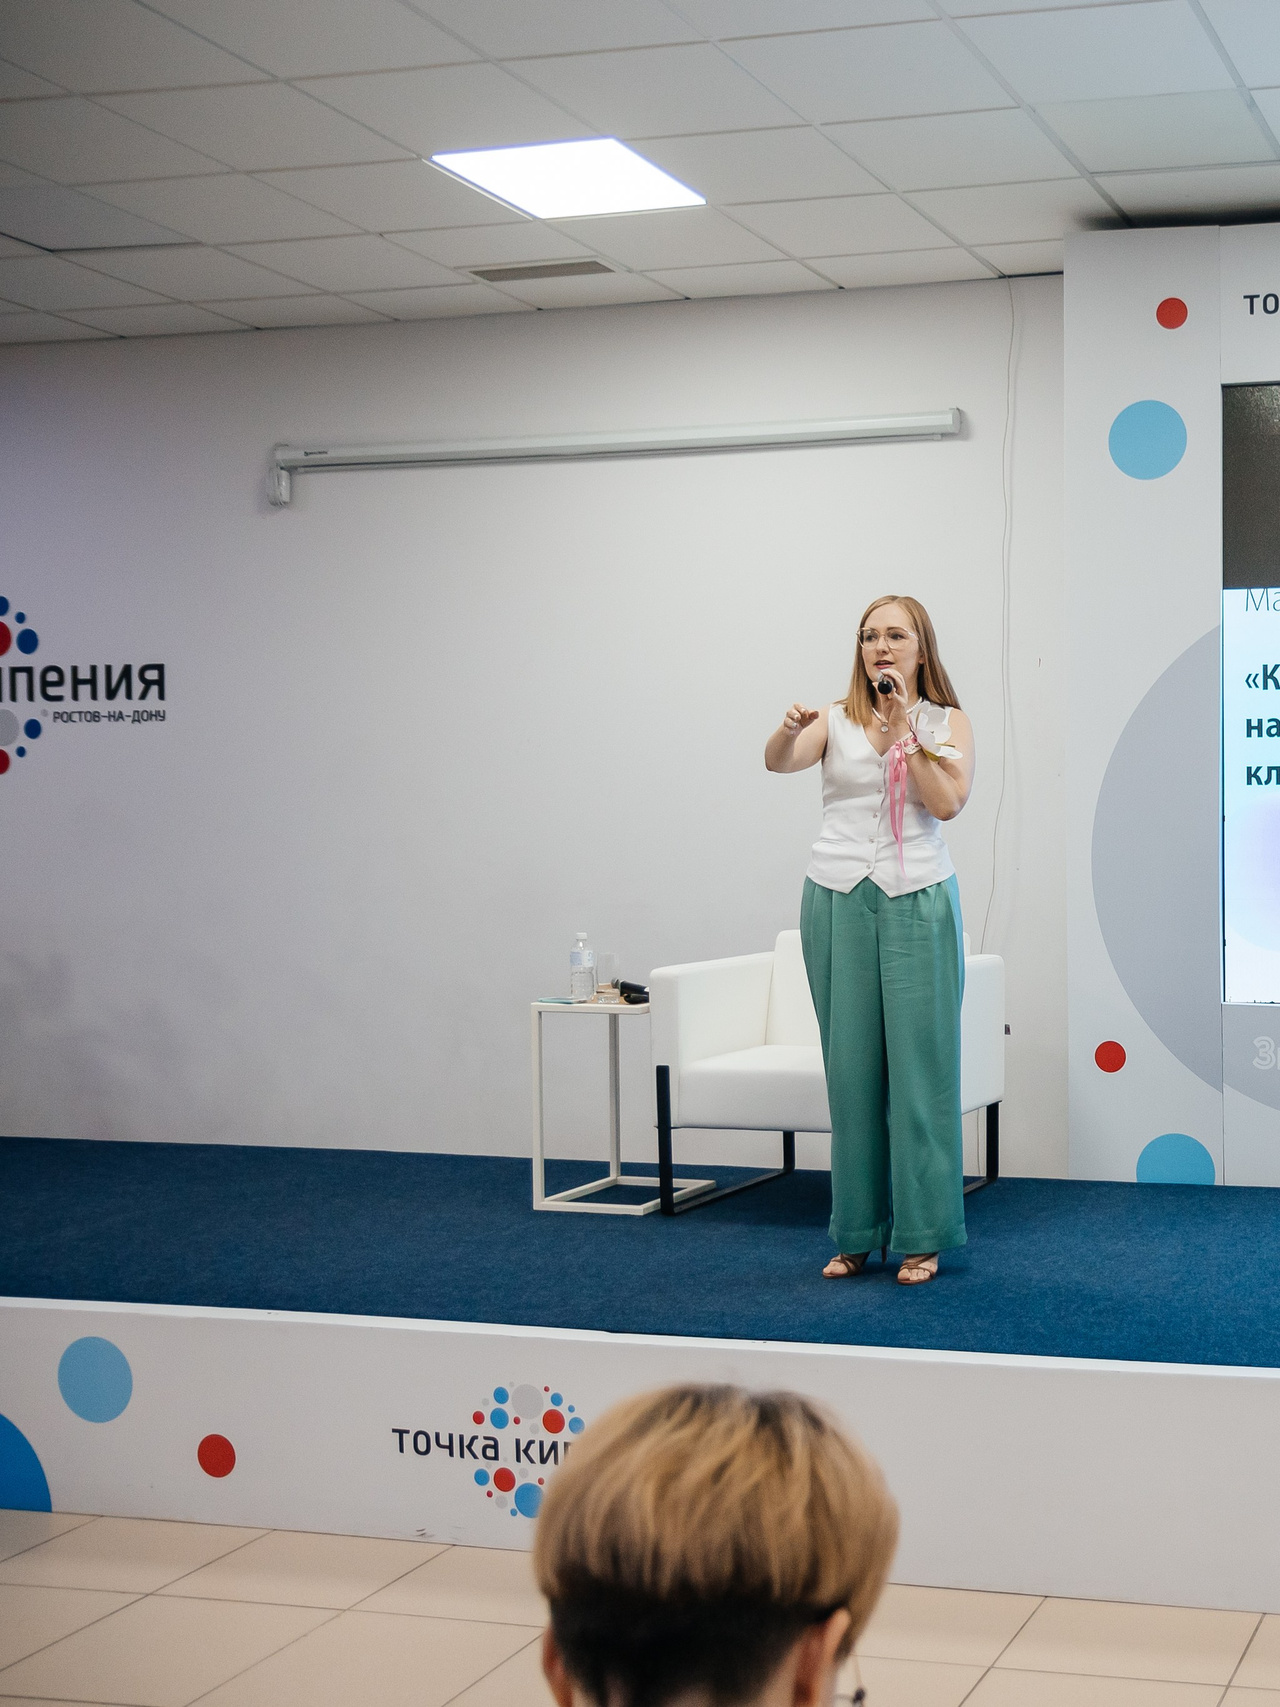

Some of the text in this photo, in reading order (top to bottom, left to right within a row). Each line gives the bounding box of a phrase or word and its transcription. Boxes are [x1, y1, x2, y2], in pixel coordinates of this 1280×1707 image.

[0, 663, 165, 702] пения
[53, 710, 166, 724] РОСТОВ-НА-ДОНУ
[392, 1428, 571, 1466] точка ки
